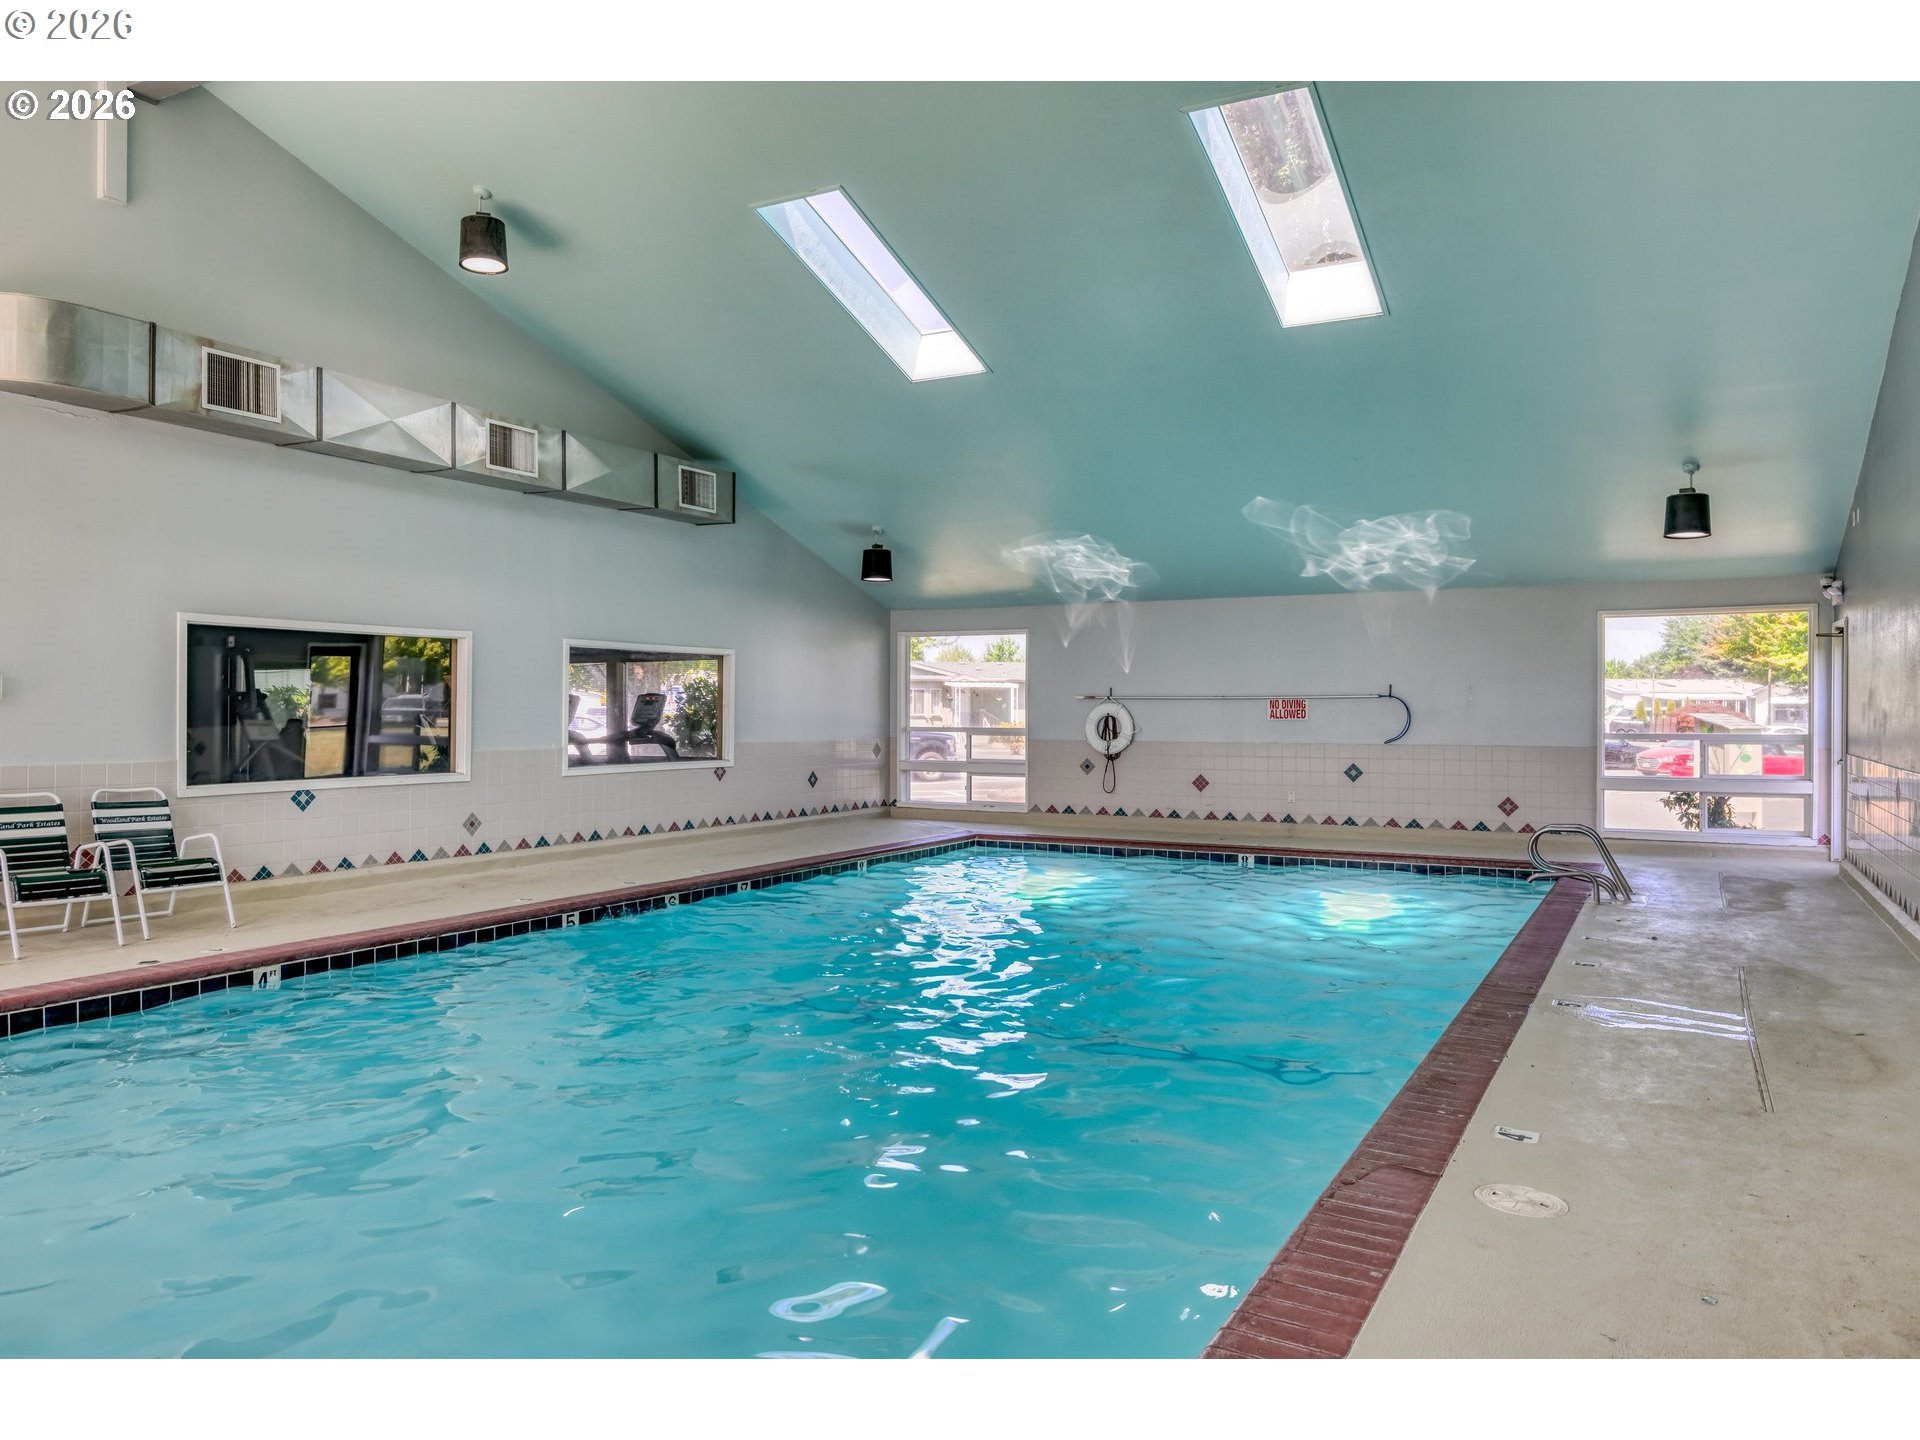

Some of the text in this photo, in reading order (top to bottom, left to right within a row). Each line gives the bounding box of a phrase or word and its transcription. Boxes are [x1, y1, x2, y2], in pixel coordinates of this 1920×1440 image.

[1269, 699, 1306, 709] NO DIVING
[1269, 709, 1307, 719] ALLOWED
[101, 816, 131, 825] Woodland
[566, 913, 576, 928] 5
